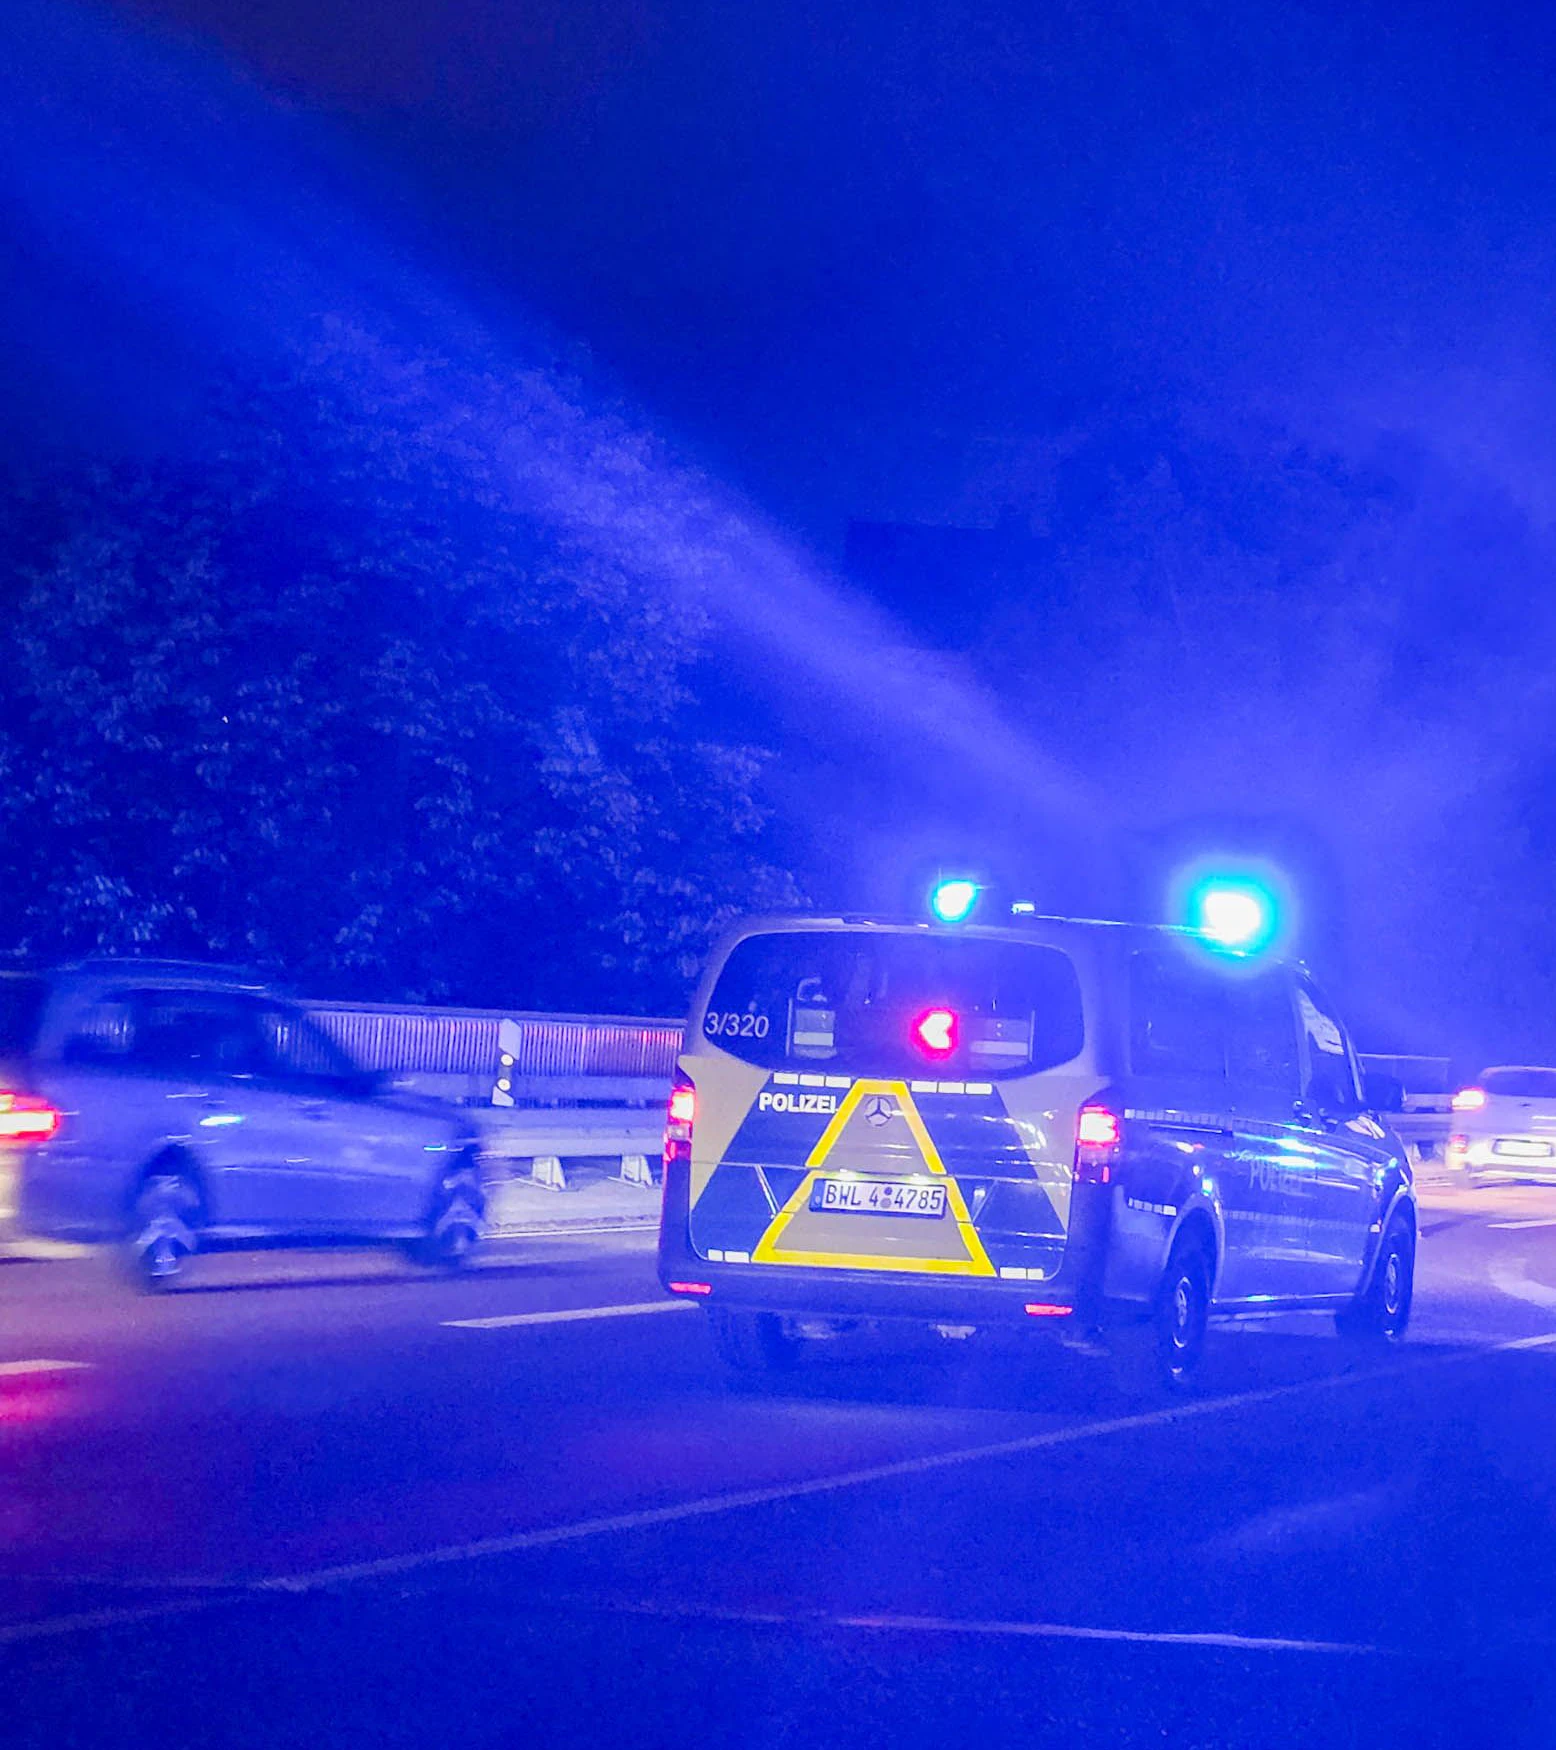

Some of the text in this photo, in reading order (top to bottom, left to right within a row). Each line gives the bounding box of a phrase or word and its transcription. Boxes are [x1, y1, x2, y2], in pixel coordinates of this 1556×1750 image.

[705, 1011, 769, 1038] 3/320
[758, 1091, 837, 1115] POLIZEI
[825, 1184, 862, 1206] BWL
